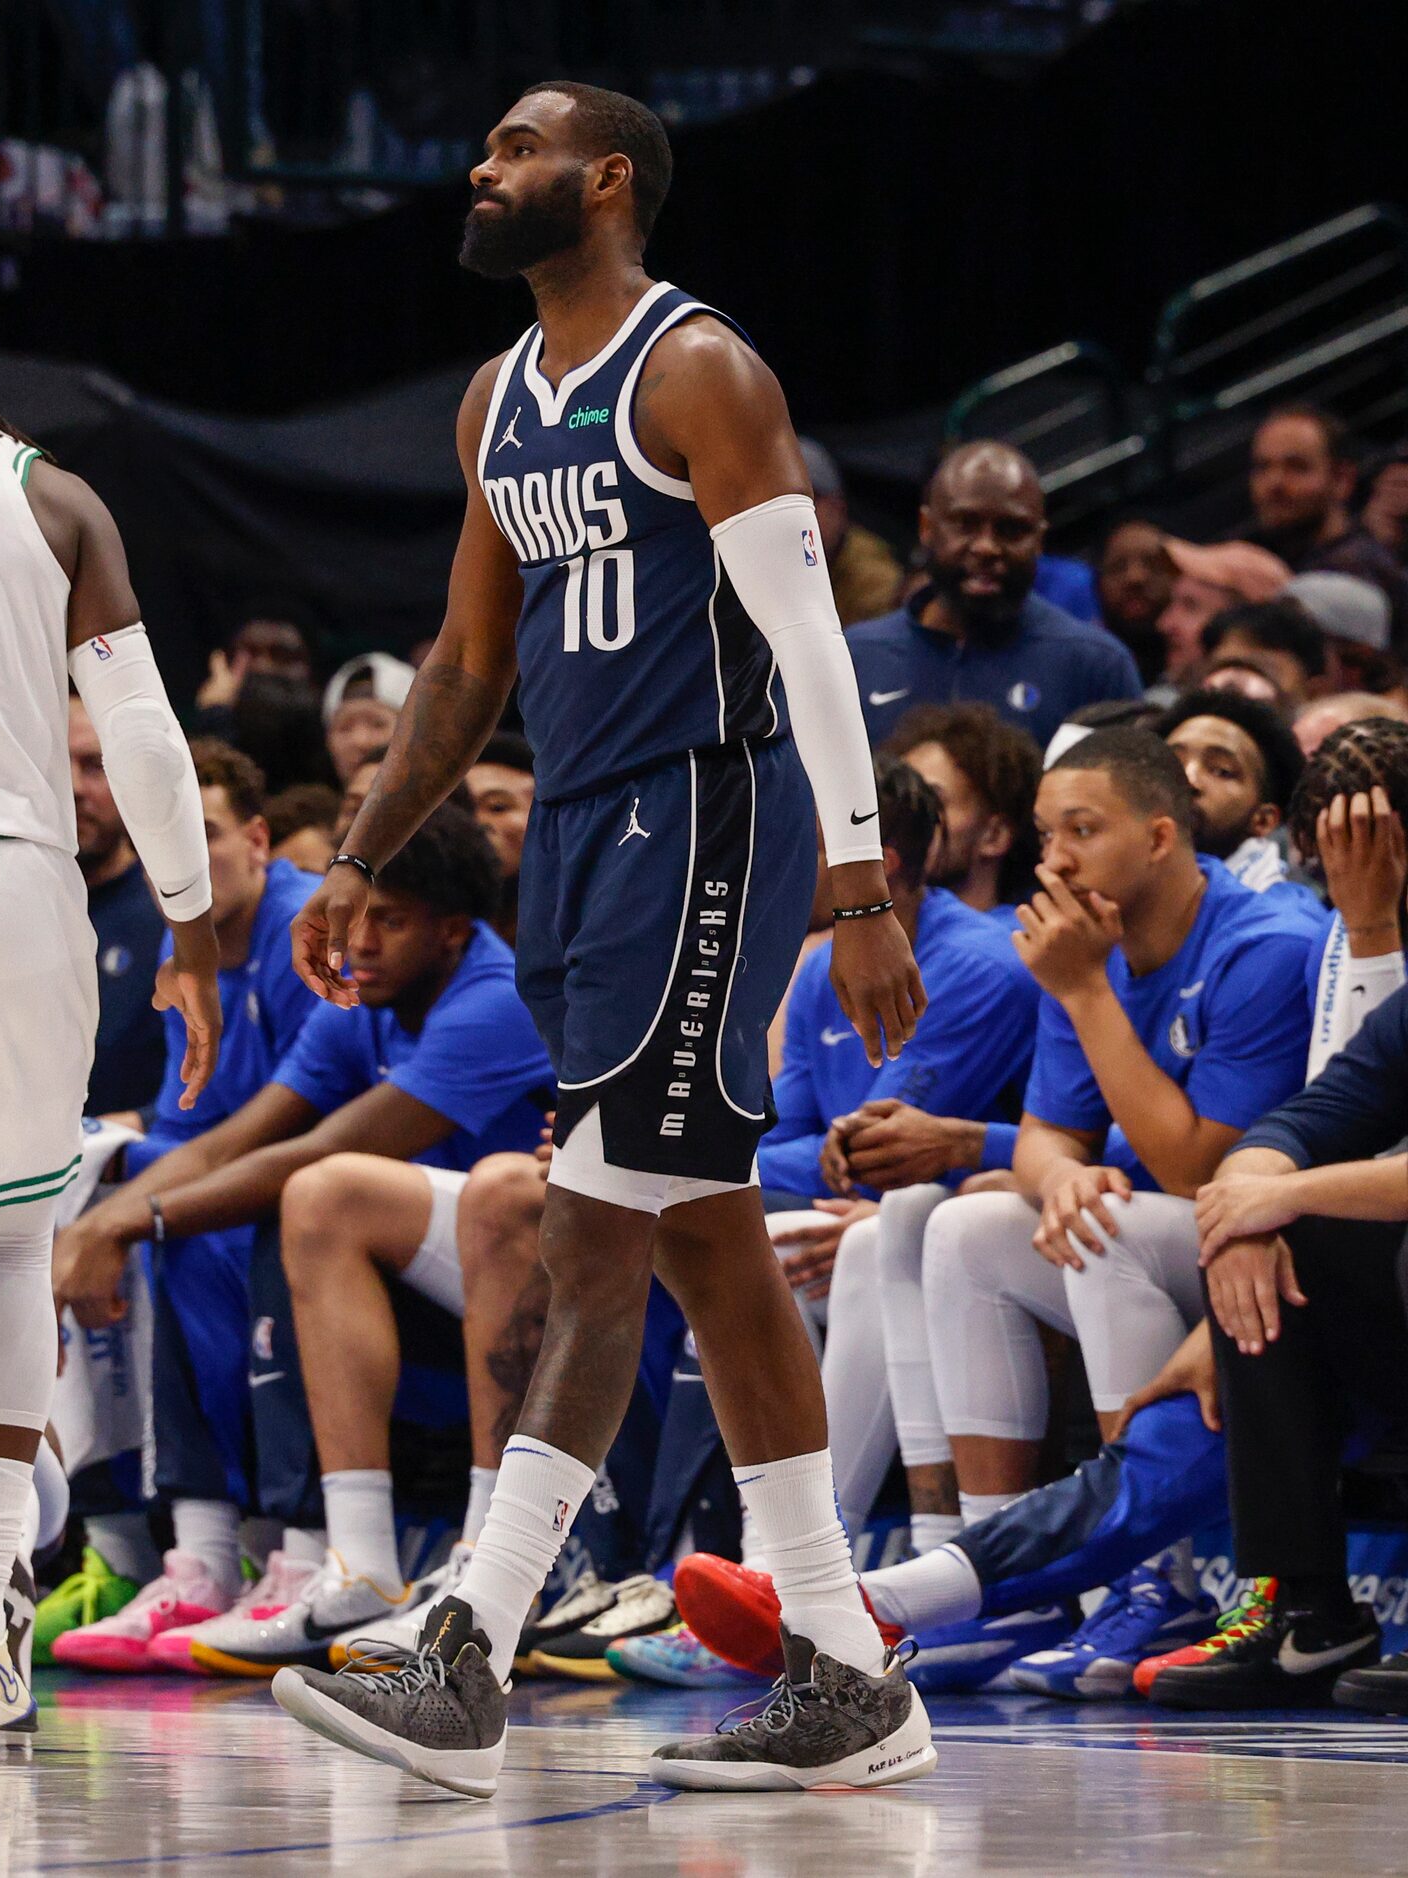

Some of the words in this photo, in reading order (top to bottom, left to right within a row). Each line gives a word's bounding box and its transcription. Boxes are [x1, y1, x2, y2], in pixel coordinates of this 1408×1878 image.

[568, 405, 610, 430] chime
[483, 460, 630, 563] MAVS
[558, 549, 636, 654] 10
[658, 879, 729, 1137] MAVERICKS
